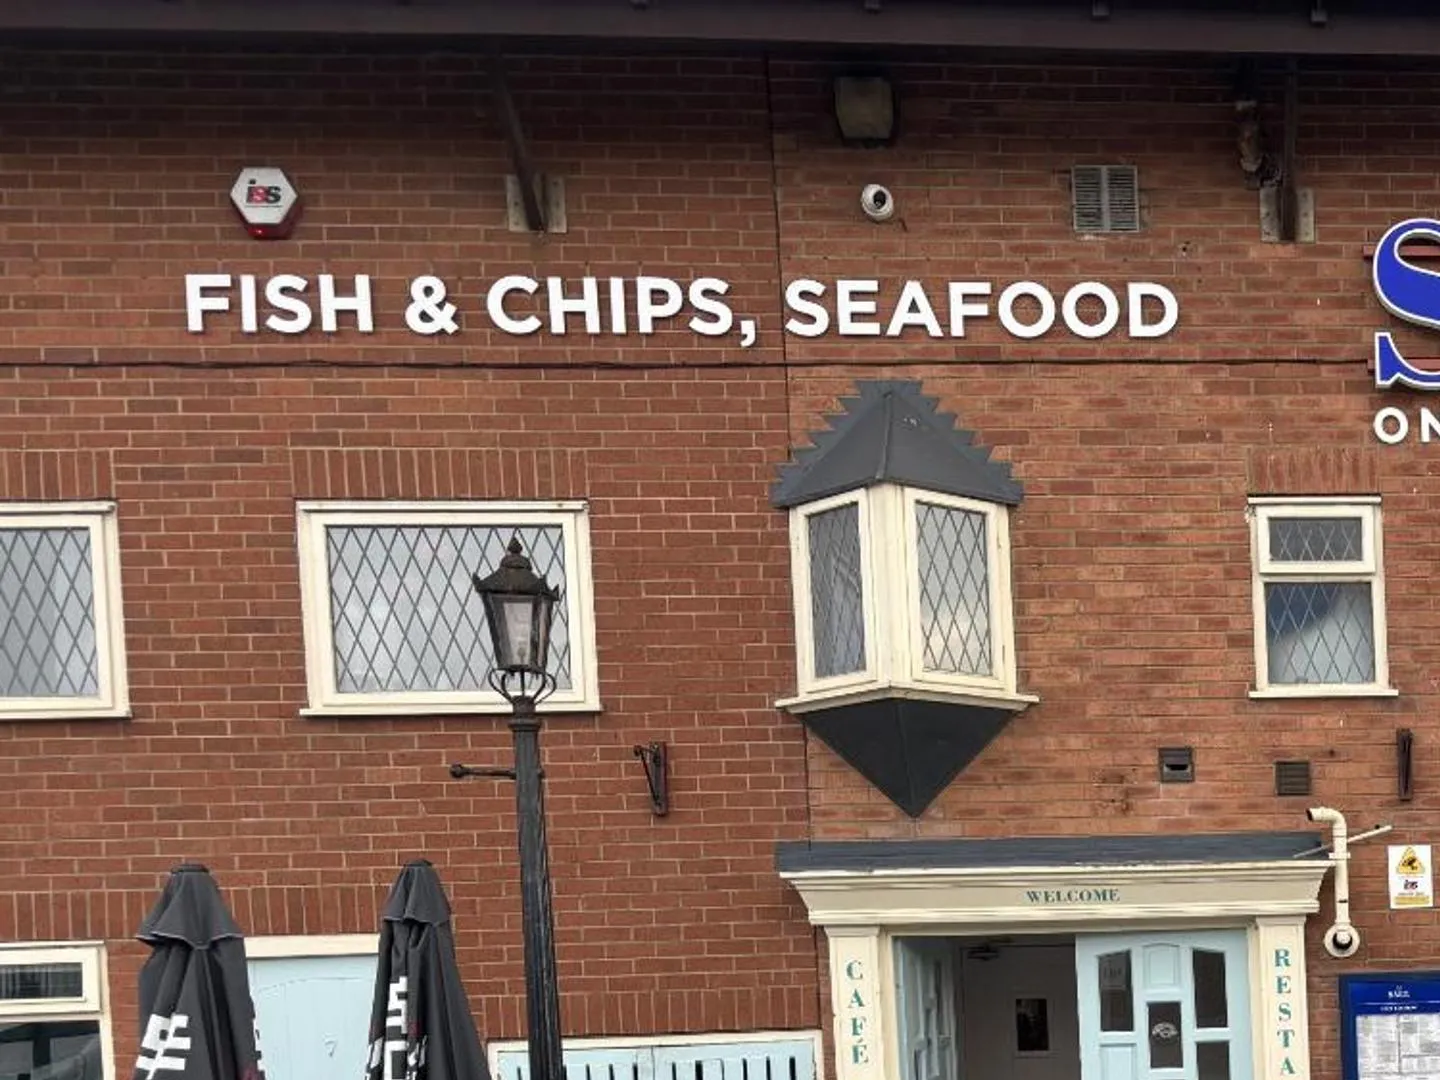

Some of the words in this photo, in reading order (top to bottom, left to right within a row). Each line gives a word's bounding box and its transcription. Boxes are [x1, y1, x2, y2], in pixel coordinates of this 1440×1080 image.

[184, 273, 374, 335] FISH
[404, 275, 460, 335] &
[486, 275, 757, 347] CHIPS,
[785, 278, 1179, 339] SEAFOOD
[1026, 888, 1120, 904] WELCOME
[846, 960, 870, 1065] CAFÉ
